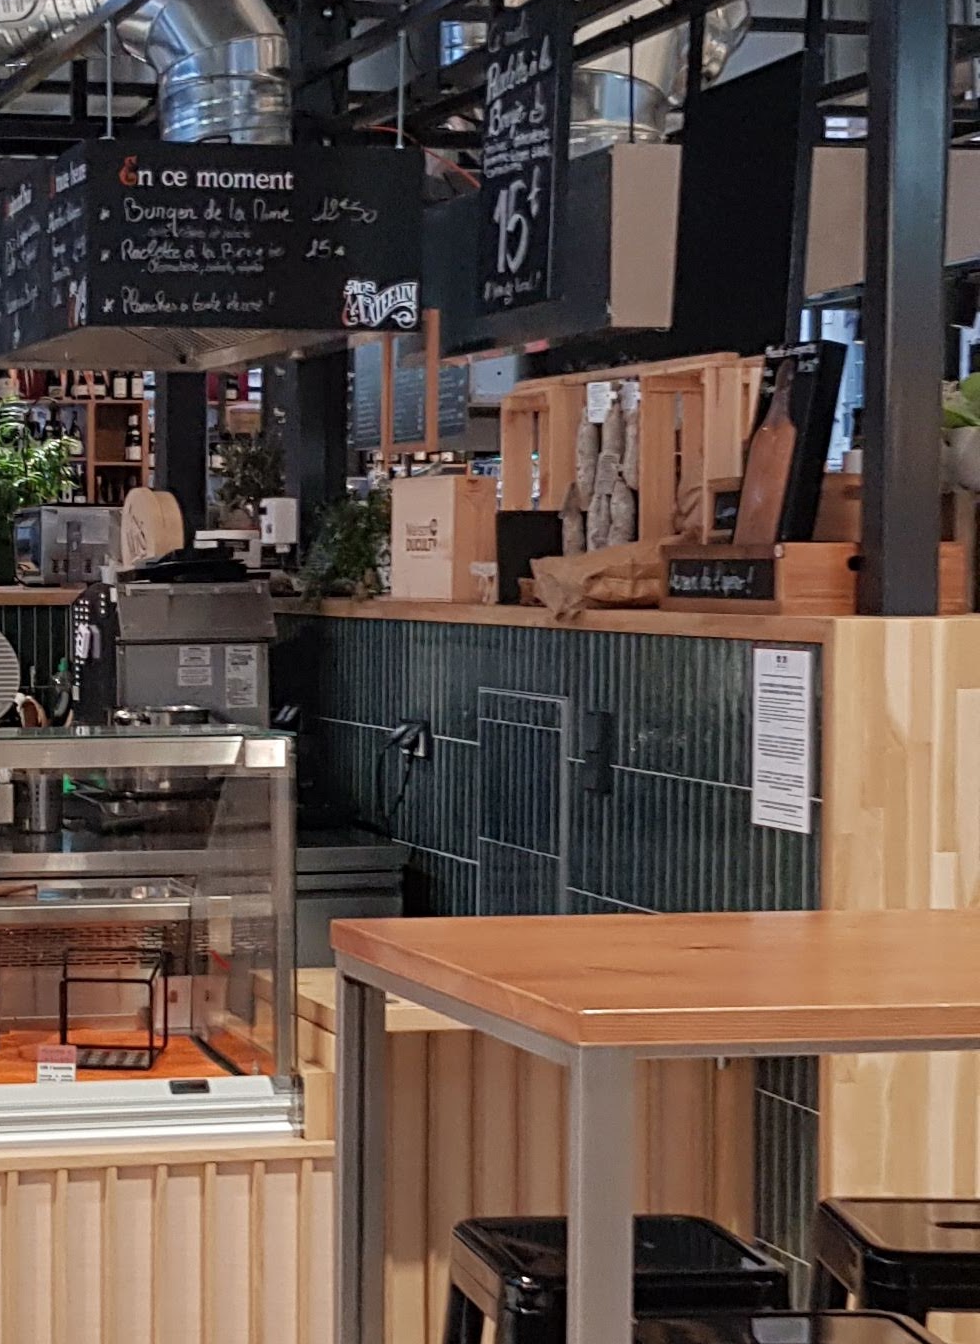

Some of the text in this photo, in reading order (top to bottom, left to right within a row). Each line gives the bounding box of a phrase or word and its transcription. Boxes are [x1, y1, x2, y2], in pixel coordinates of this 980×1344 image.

[118, 155, 295, 190] En ce moment
[123, 197, 197, 238] Burger
[204, 198, 221, 221] de
[229, 197, 246, 221] la
